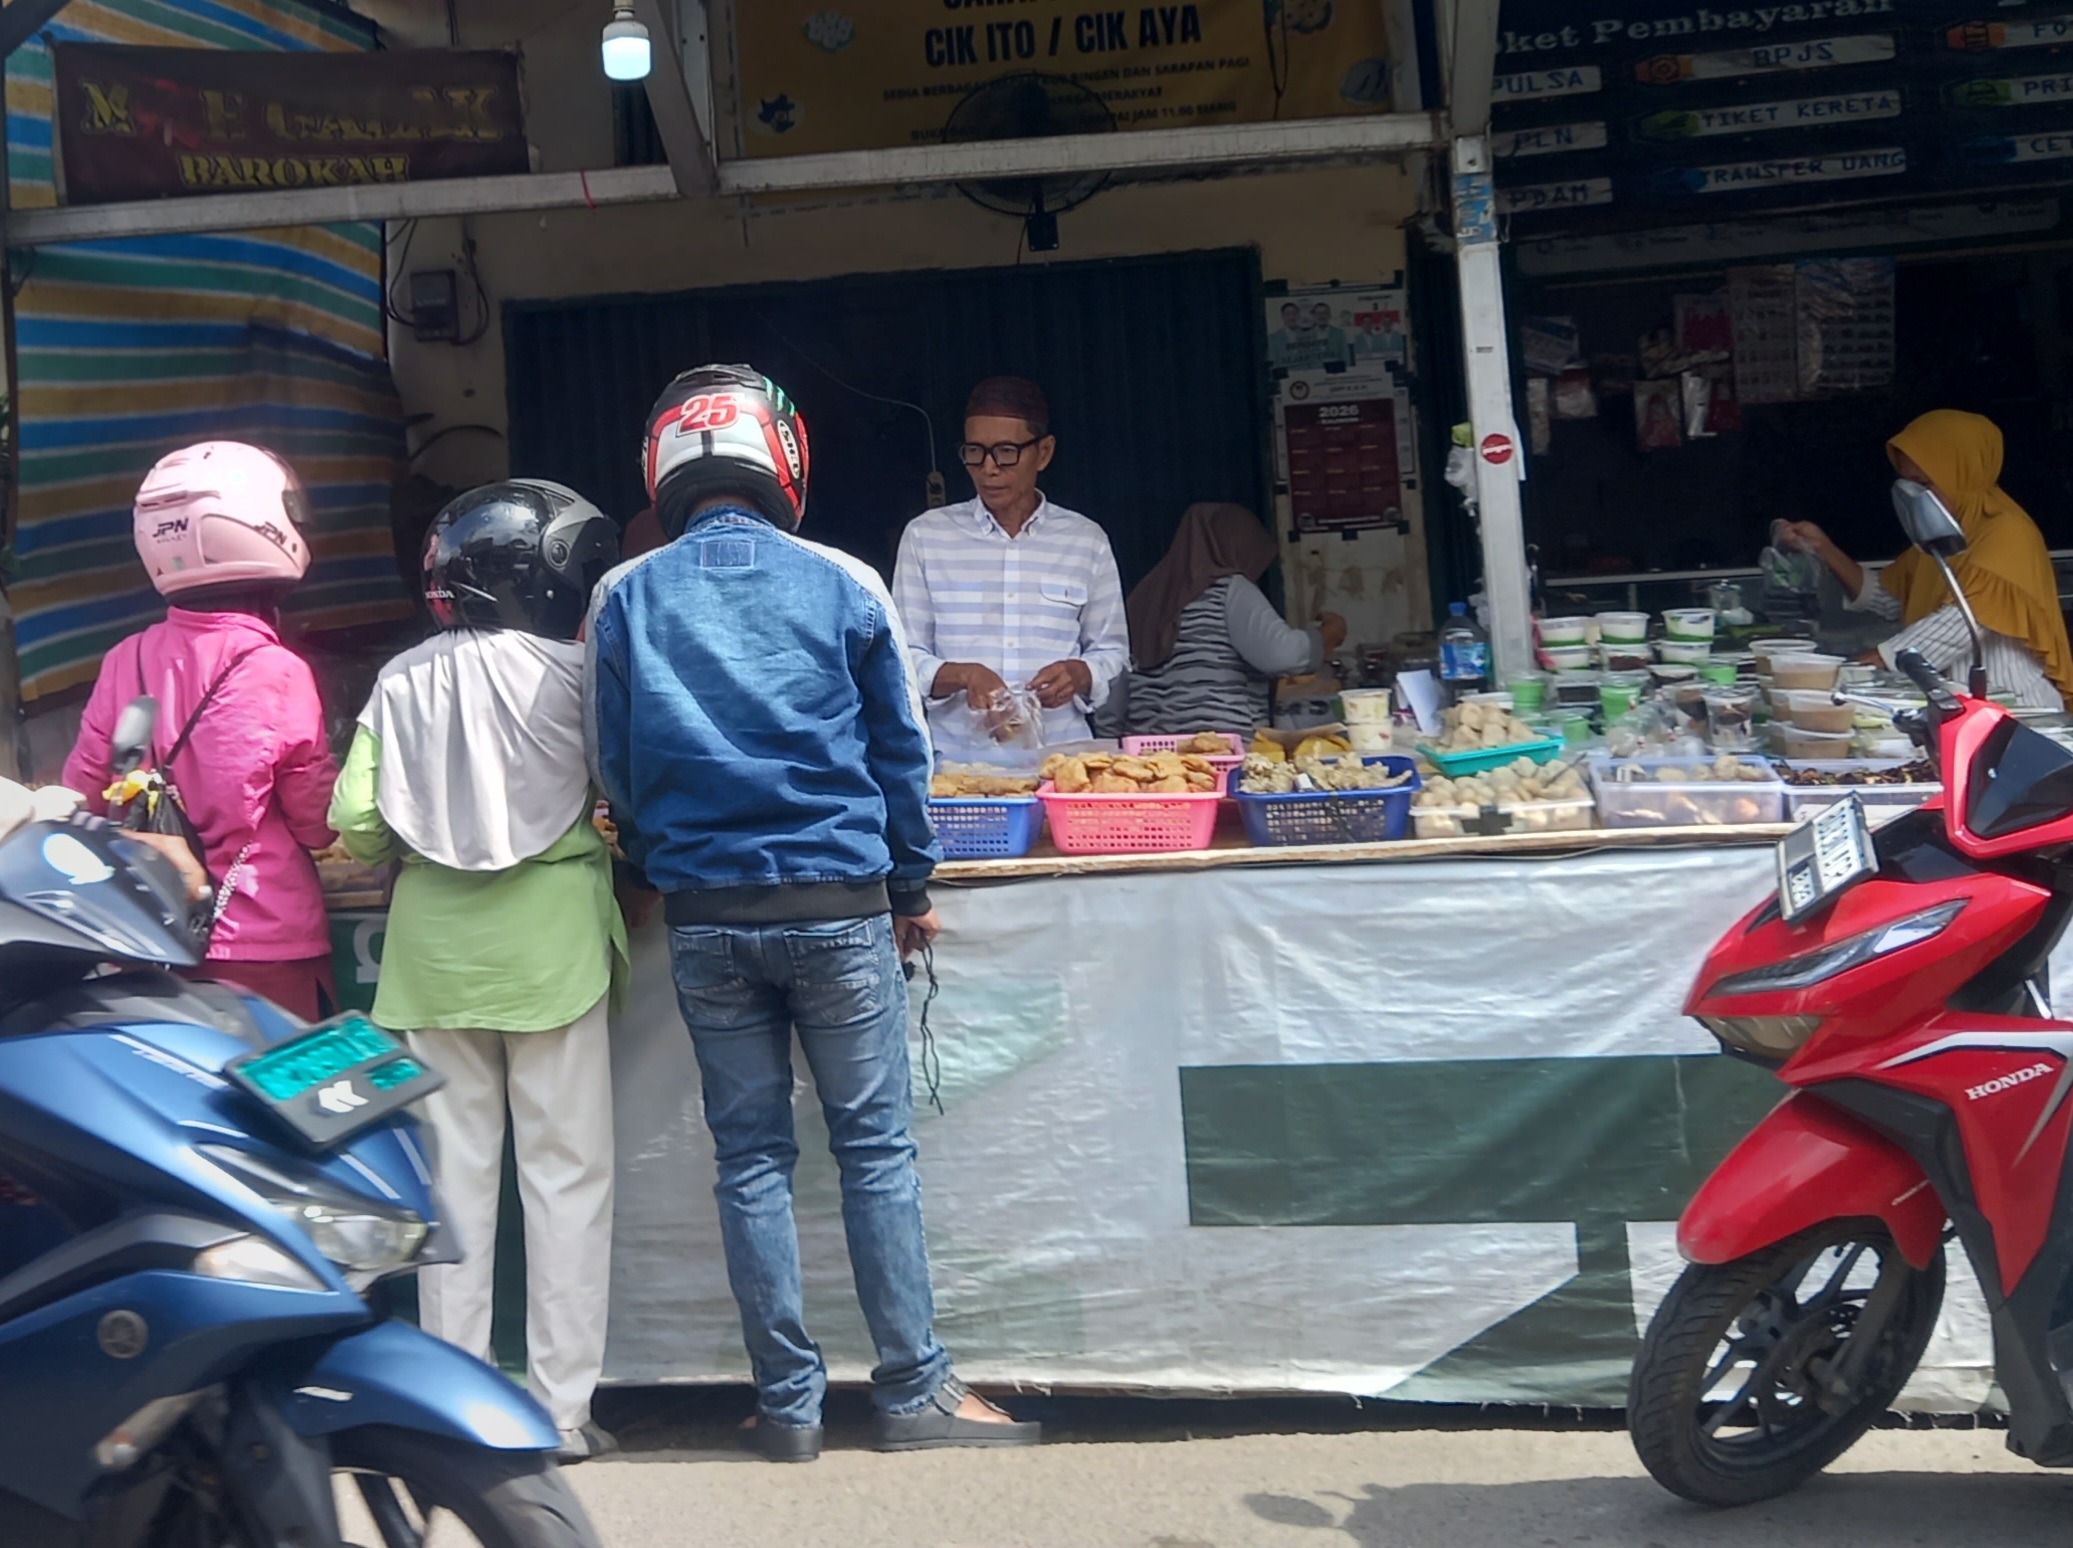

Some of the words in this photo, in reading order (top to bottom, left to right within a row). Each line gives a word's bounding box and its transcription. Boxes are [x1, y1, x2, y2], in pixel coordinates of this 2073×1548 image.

[925, 25, 977, 67] CIK
[987, 20, 1035, 61] ITO
[1048, 18, 1061, 57] /
[1075, 11, 1128, 53] CIK
[1139, 5, 1201, 48] AYA
[1496, 25, 1580, 55] ket
[1592, 0, 1895, 45] Pembayaran
[1753, 41, 1834, 68] BPJS
[883, 88, 920, 101] SEDIA
[1123, 66, 1151, 78] DAN
[1155, 60, 1215, 76] SARAPAN
[1219, 57, 1250, 70] PAGI
[1096, 86, 1163, 102] MERAKYAT
[1131, 107, 1158, 121] JAM
[1702, 106, 1777, 128] TIKET
[1796, 95, 1893, 118] KERETA
[1513, 127, 1573, 149] PLN
[179, 153, 411, 187] BAROKAH
[1704, 160, 1824, 184] TRANSFER
[1841, 152, 1906, 171] UANG
[1509, 183, 1589, 208] PDAM
[677, 393, 746, 435] 25
[152, 515, 190, 538] JPN
[253, 521, 288, 545] JPN
[1964, 1063, 2055, 1101] HONDA
